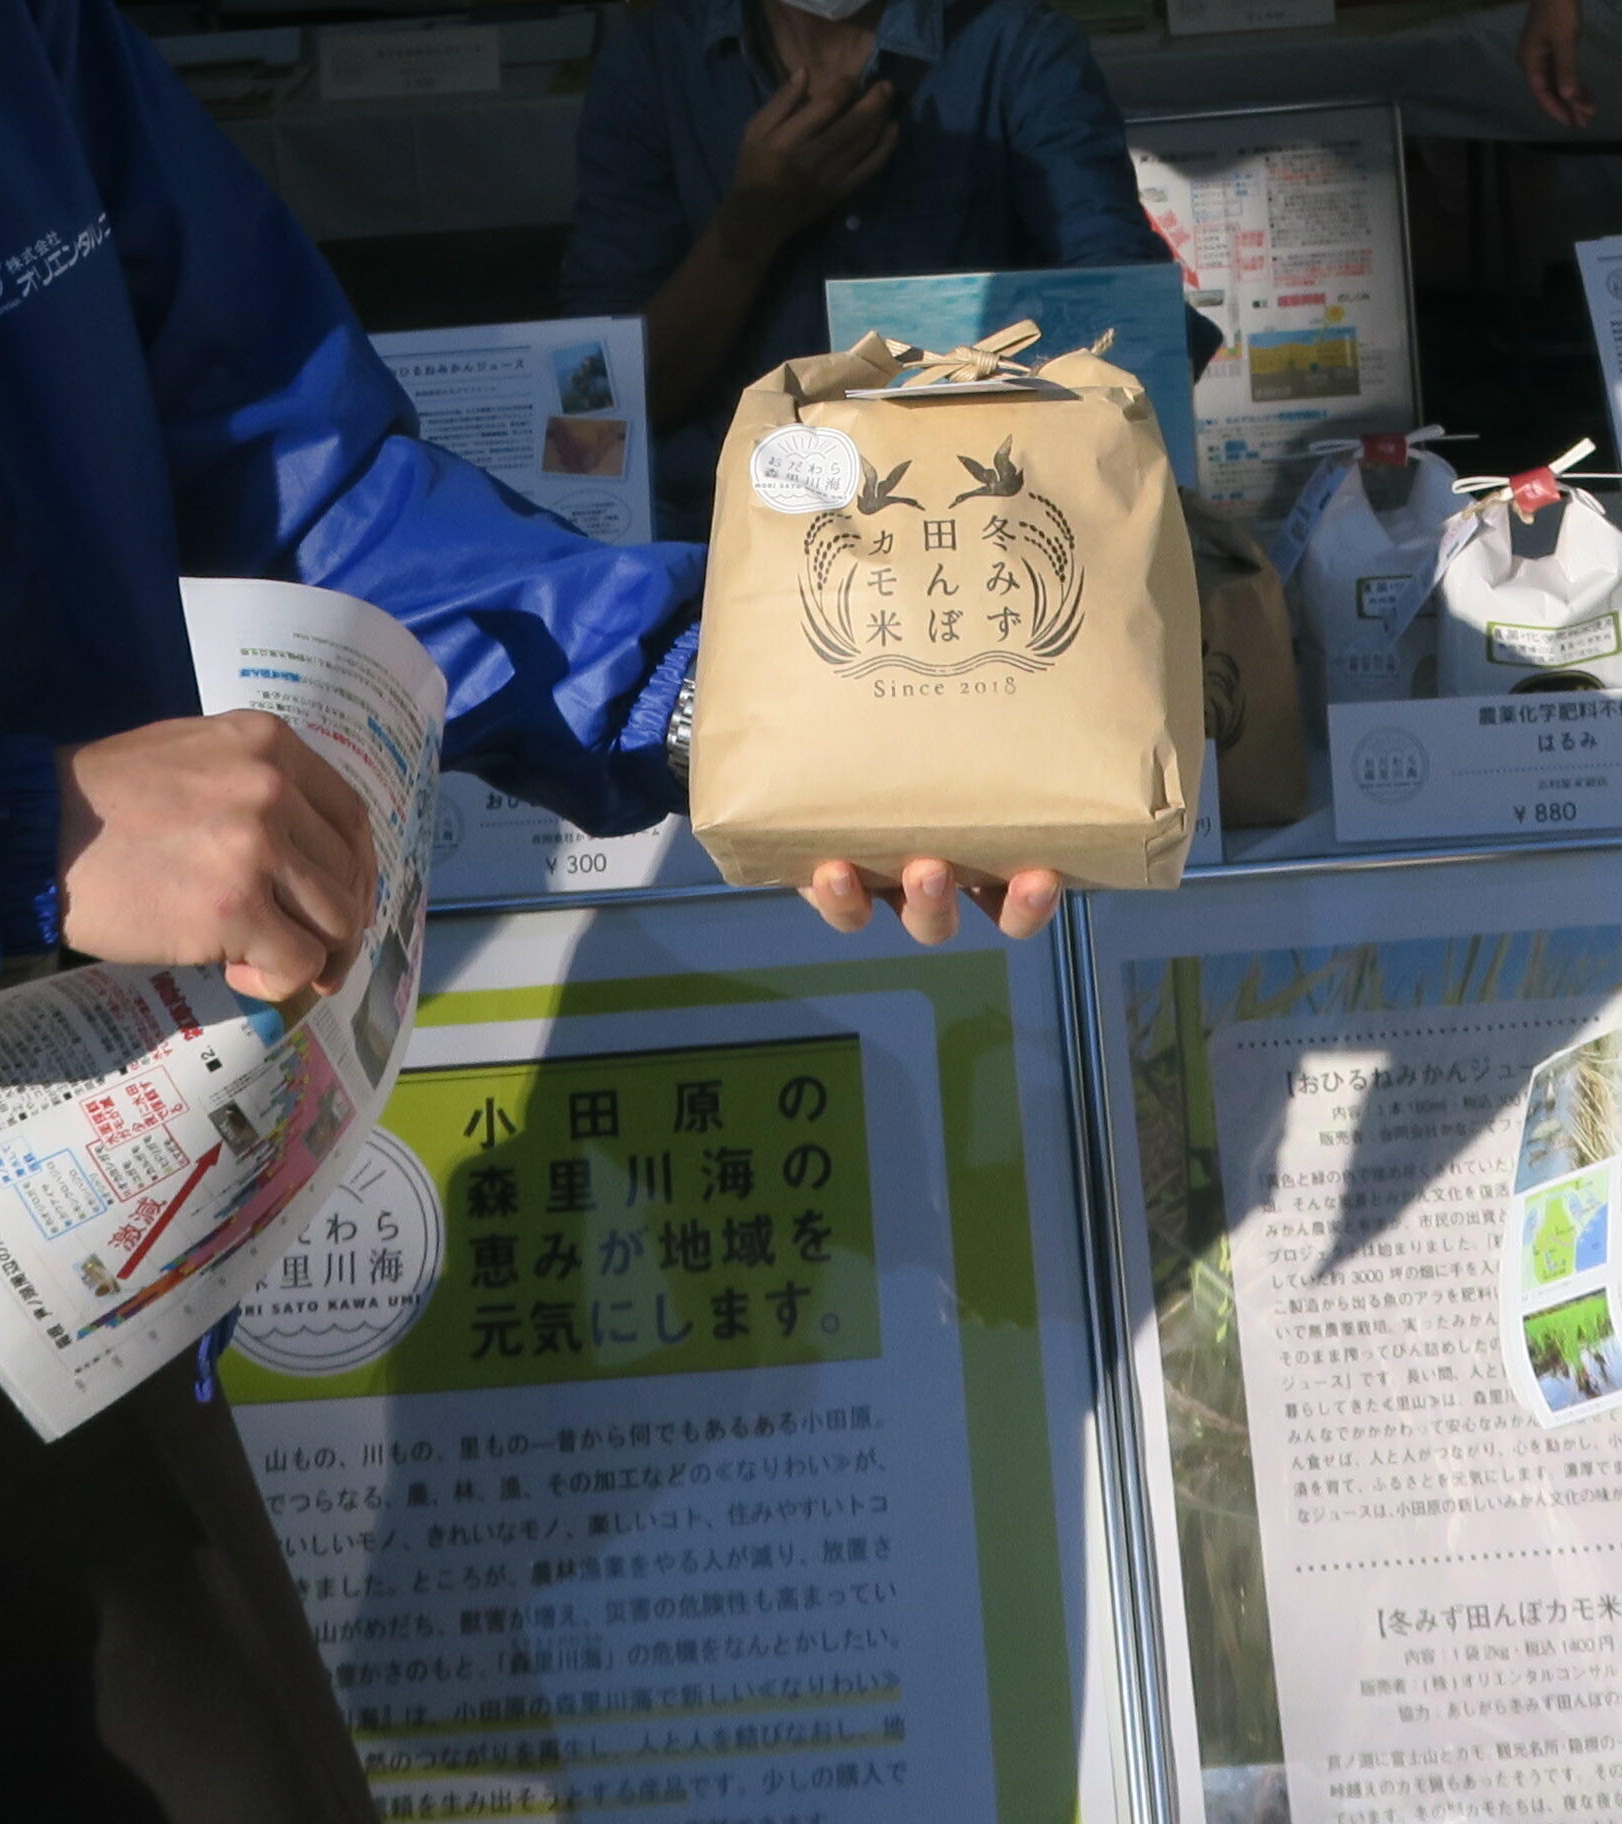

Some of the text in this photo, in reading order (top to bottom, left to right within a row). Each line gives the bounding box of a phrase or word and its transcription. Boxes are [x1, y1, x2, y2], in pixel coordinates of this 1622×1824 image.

[5, 230, 62, 275] 株式会社
[767, 455, 841, 476] おだわら
[873, 676, 1018, 698] Since 2018
[1537, 731, 1599, 754] はるみ
[464, 1075, 828, 1150] 小田原の
[466, 1144, 833, 1218] 森里川海の
[298, 1210, 400, 1246] わら
[468, 1209, 833, 1289] 恵みが地域を
[255, 1247, 404, 1293] 里川海
[272, 1299, 319, 1316] SATO
[328, 1296, 380, 1312] KAWA
[387, 1293, 421, 1307] UMI
[470, 1280, 841, 1361] 元気にします。
[280, 1493, 890, 1559] いしいモノ、きれいなモノ、楽しいコト、住みやすいトコ
